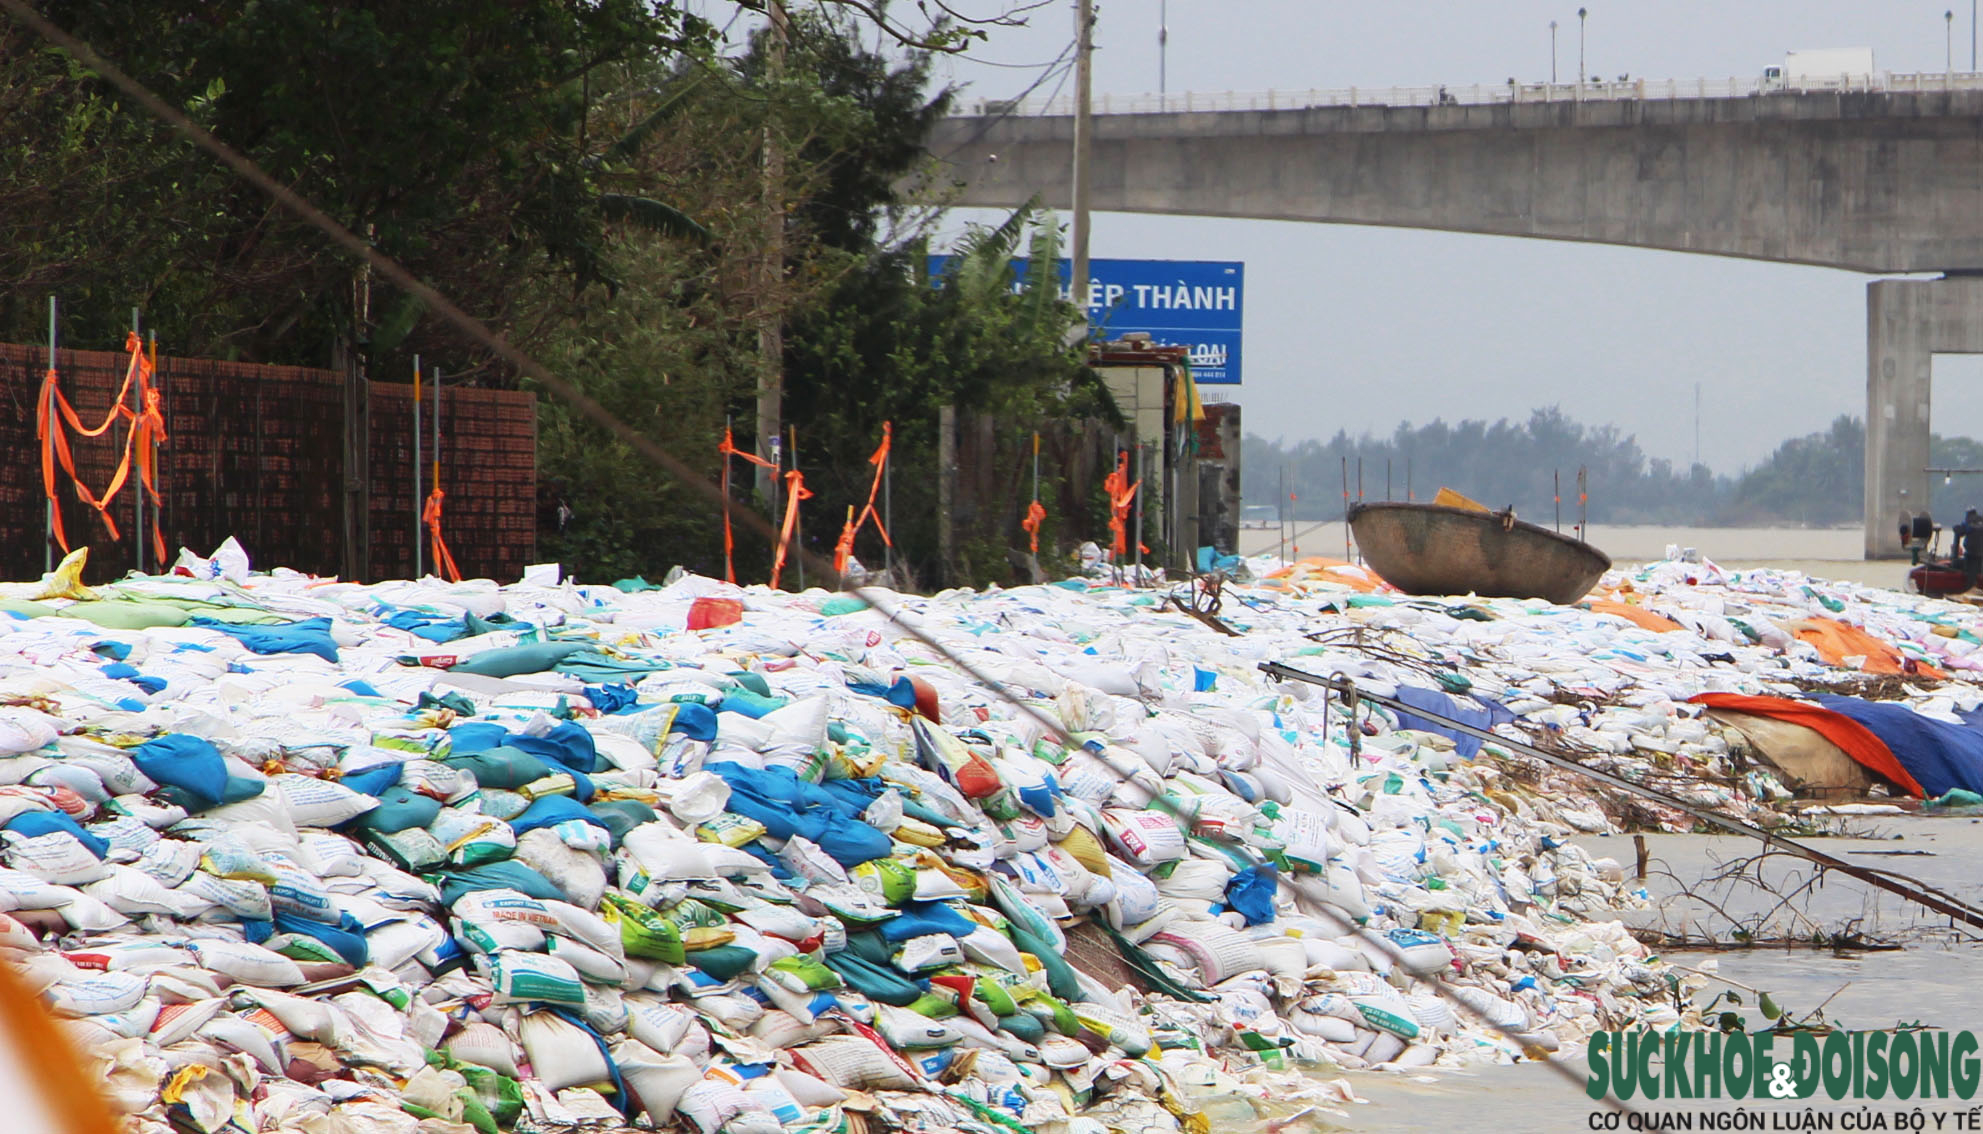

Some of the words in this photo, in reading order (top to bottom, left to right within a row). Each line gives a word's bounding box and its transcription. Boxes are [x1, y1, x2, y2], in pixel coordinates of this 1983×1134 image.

[1133, 279, 1236, 310] THÀNH
[492, 910, 517, 920] MADE
[518, 911, 527, 921] IN
